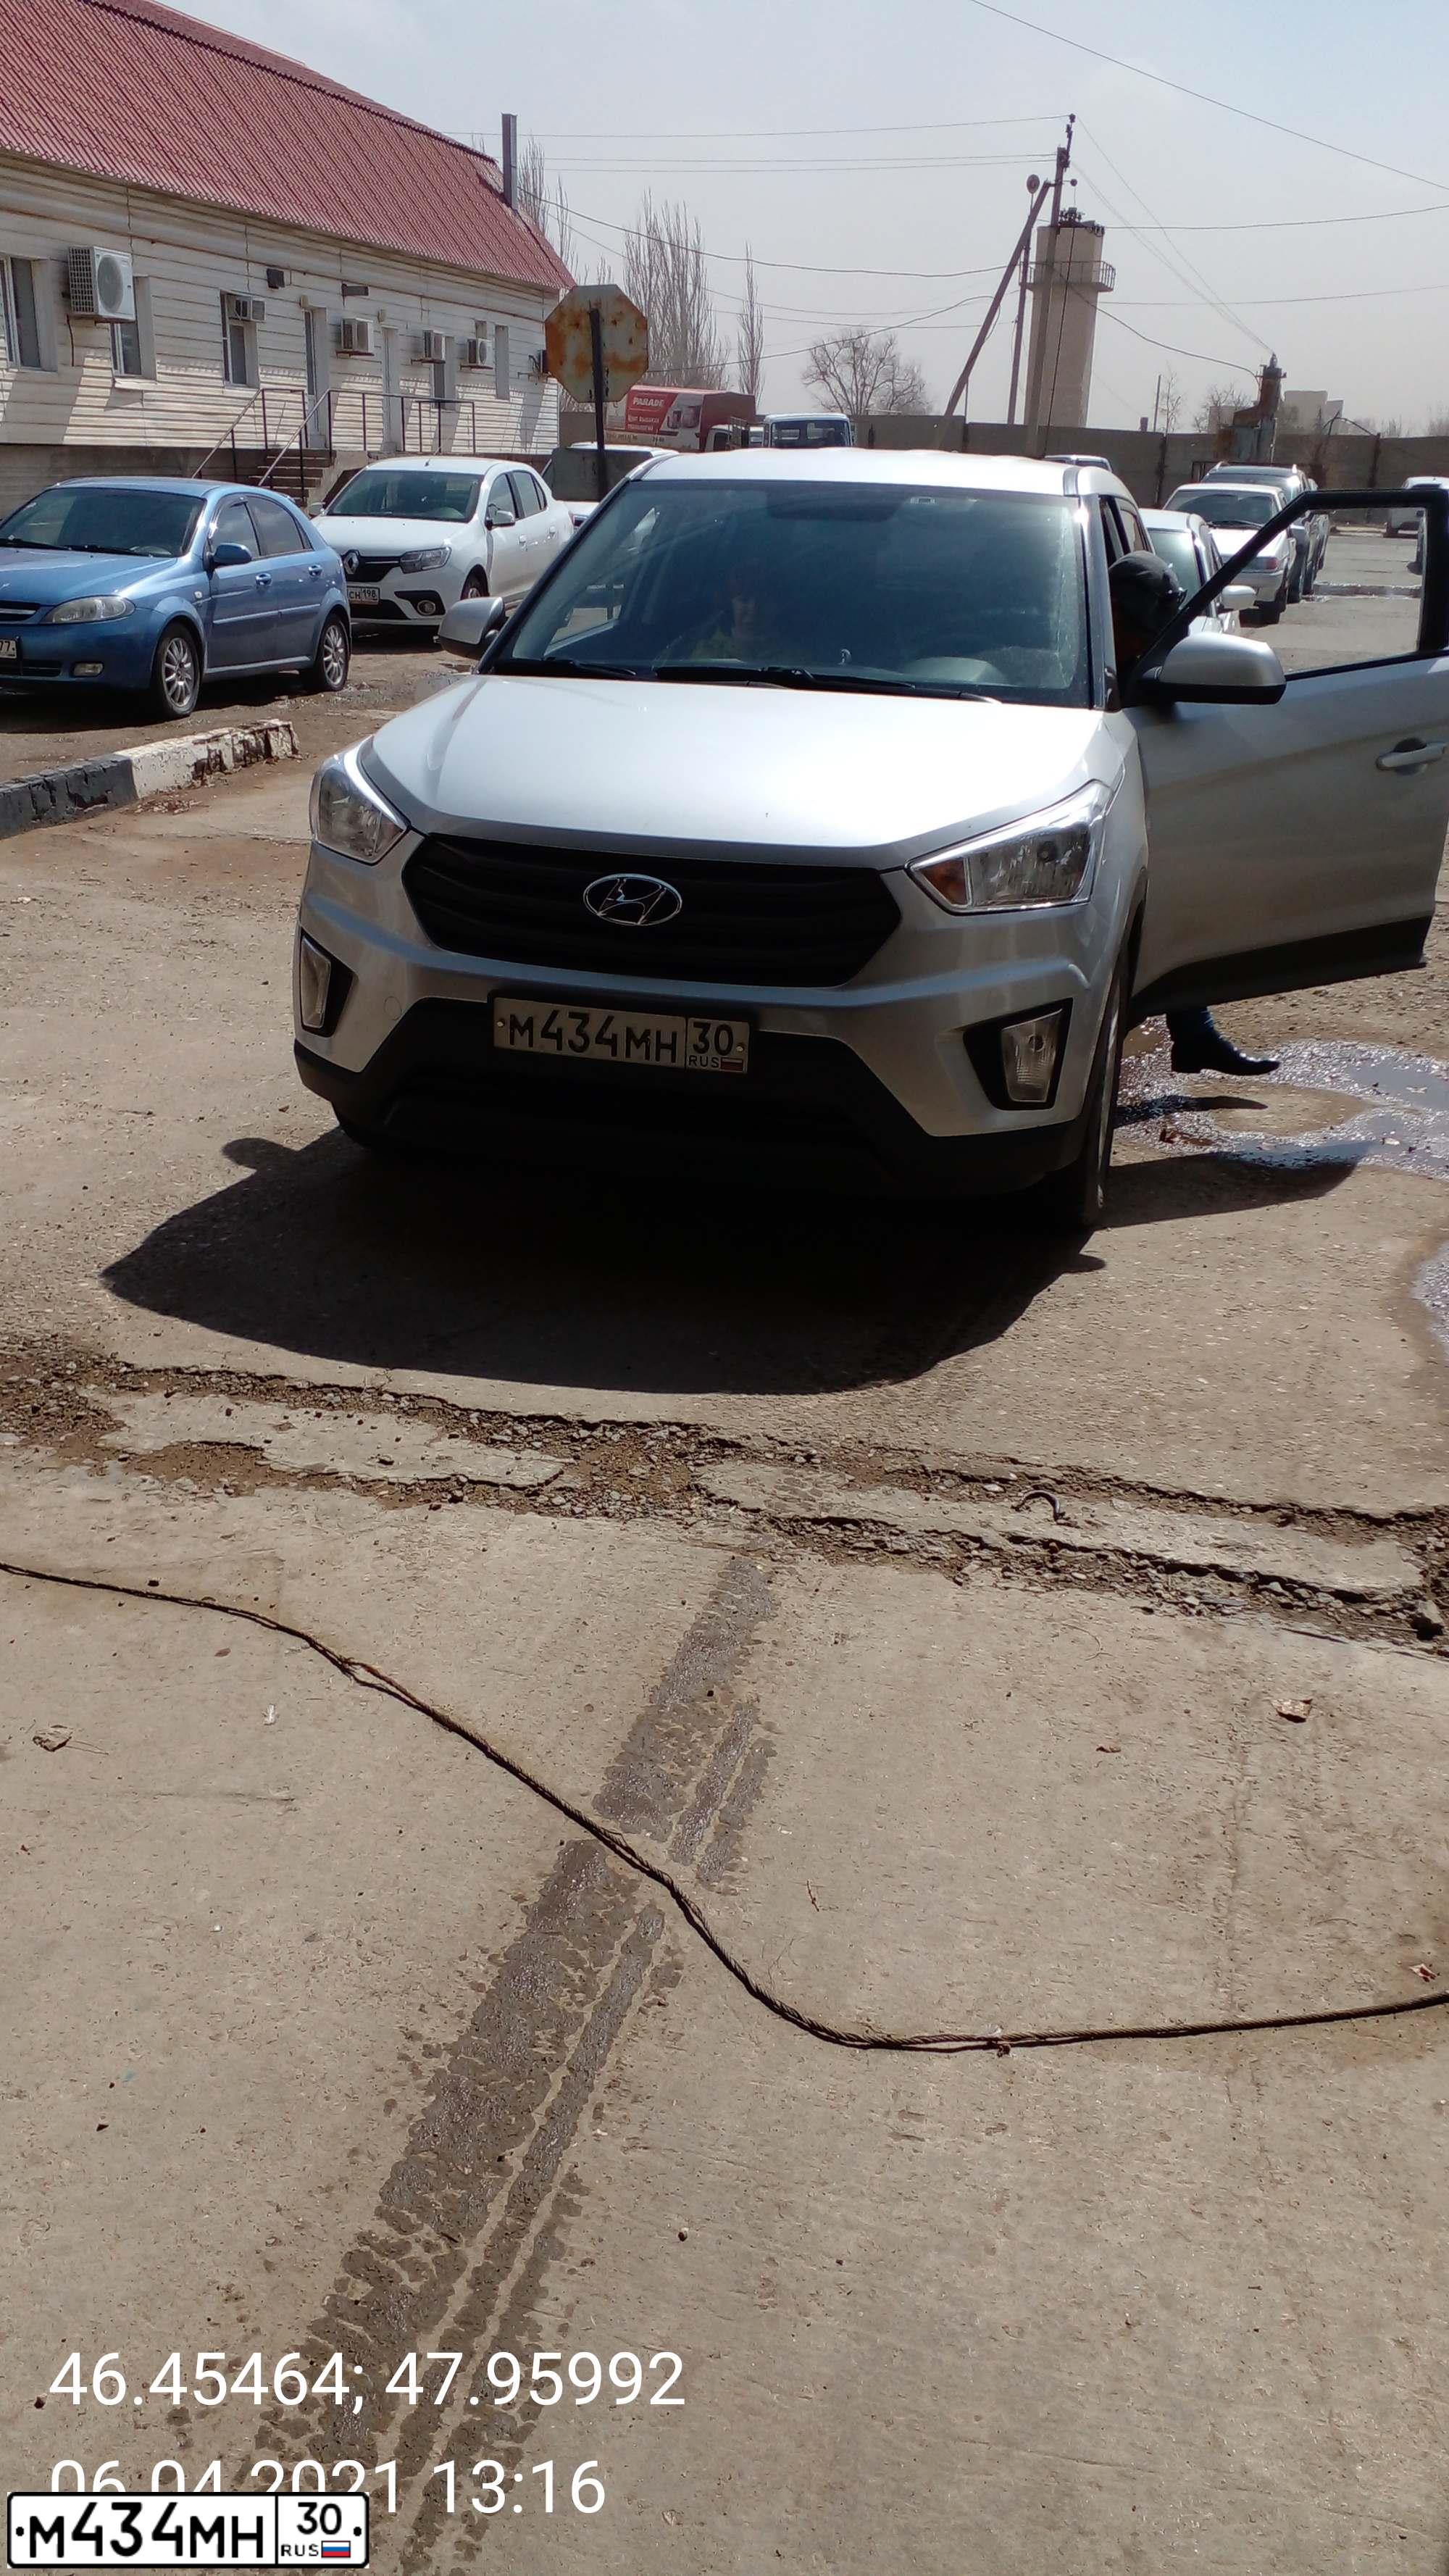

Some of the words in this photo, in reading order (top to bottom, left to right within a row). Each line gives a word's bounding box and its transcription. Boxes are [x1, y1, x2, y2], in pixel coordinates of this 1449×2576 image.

[632, 397, 664, 407] PARADE
[362, 589, 377, 598] 198
[509, 1009, 678, 1064] М434МН
[692, 1021, 734, 1056] 30
[688, 1054, 719, 1069] RUS
